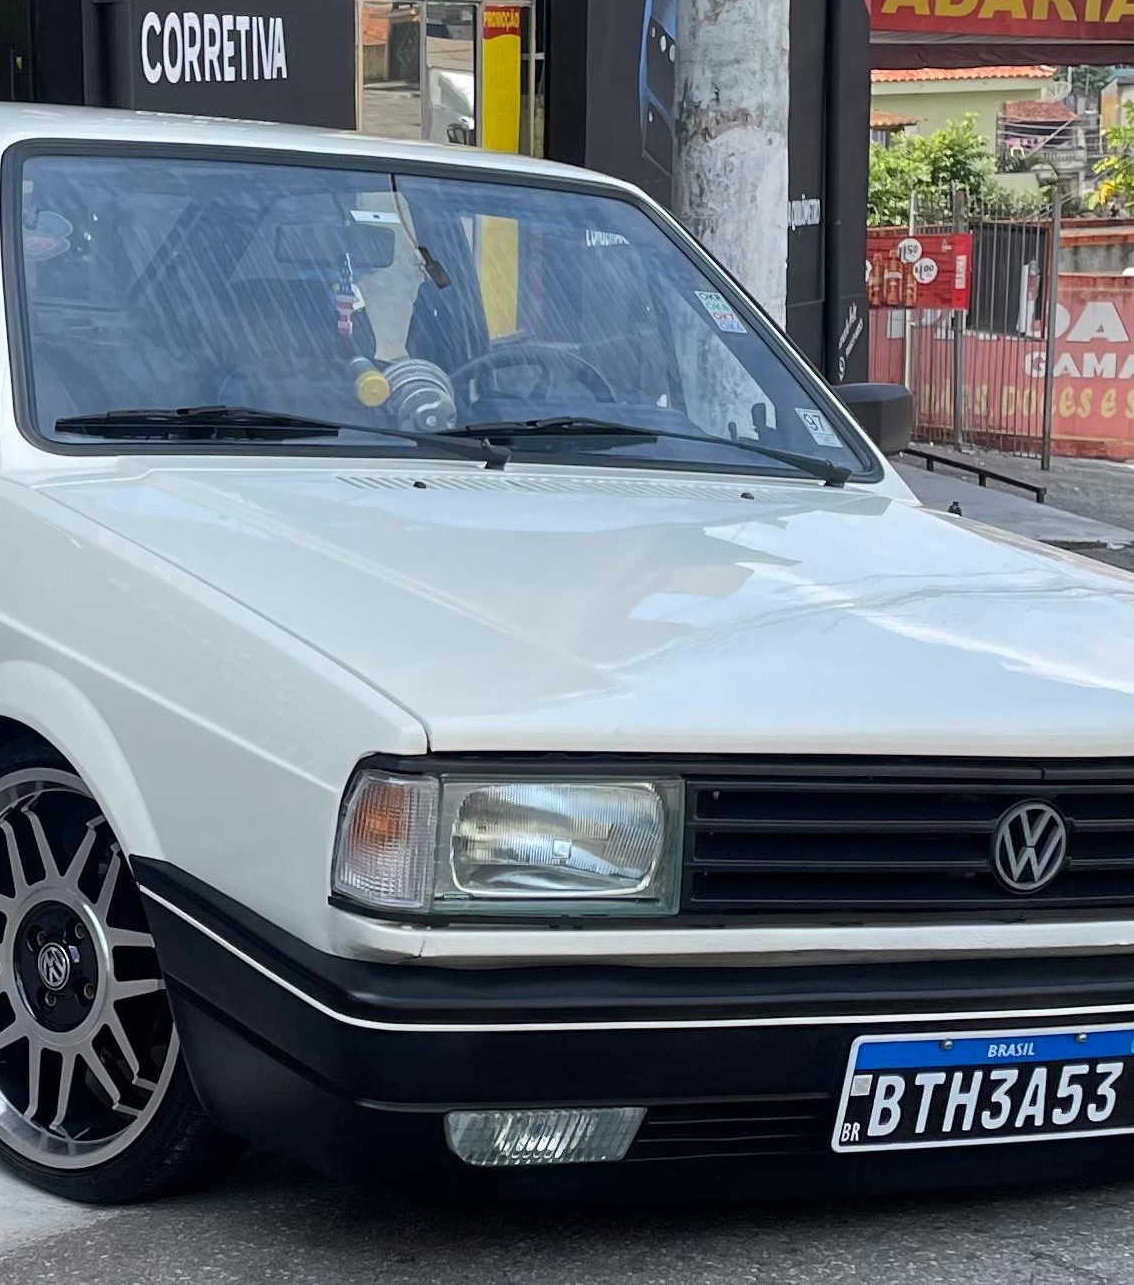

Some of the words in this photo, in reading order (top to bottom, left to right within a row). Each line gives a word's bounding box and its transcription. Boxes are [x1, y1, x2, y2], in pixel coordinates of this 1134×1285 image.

[141, 11, 288, 85] CORRETIVA
[804, 413, 825, 431] 97
[987, 1043, 1035, 1058] BRASIL
[867, 1062, 1124, 1136] BTH3A53
[841, 1122, 859, 1142] BR
